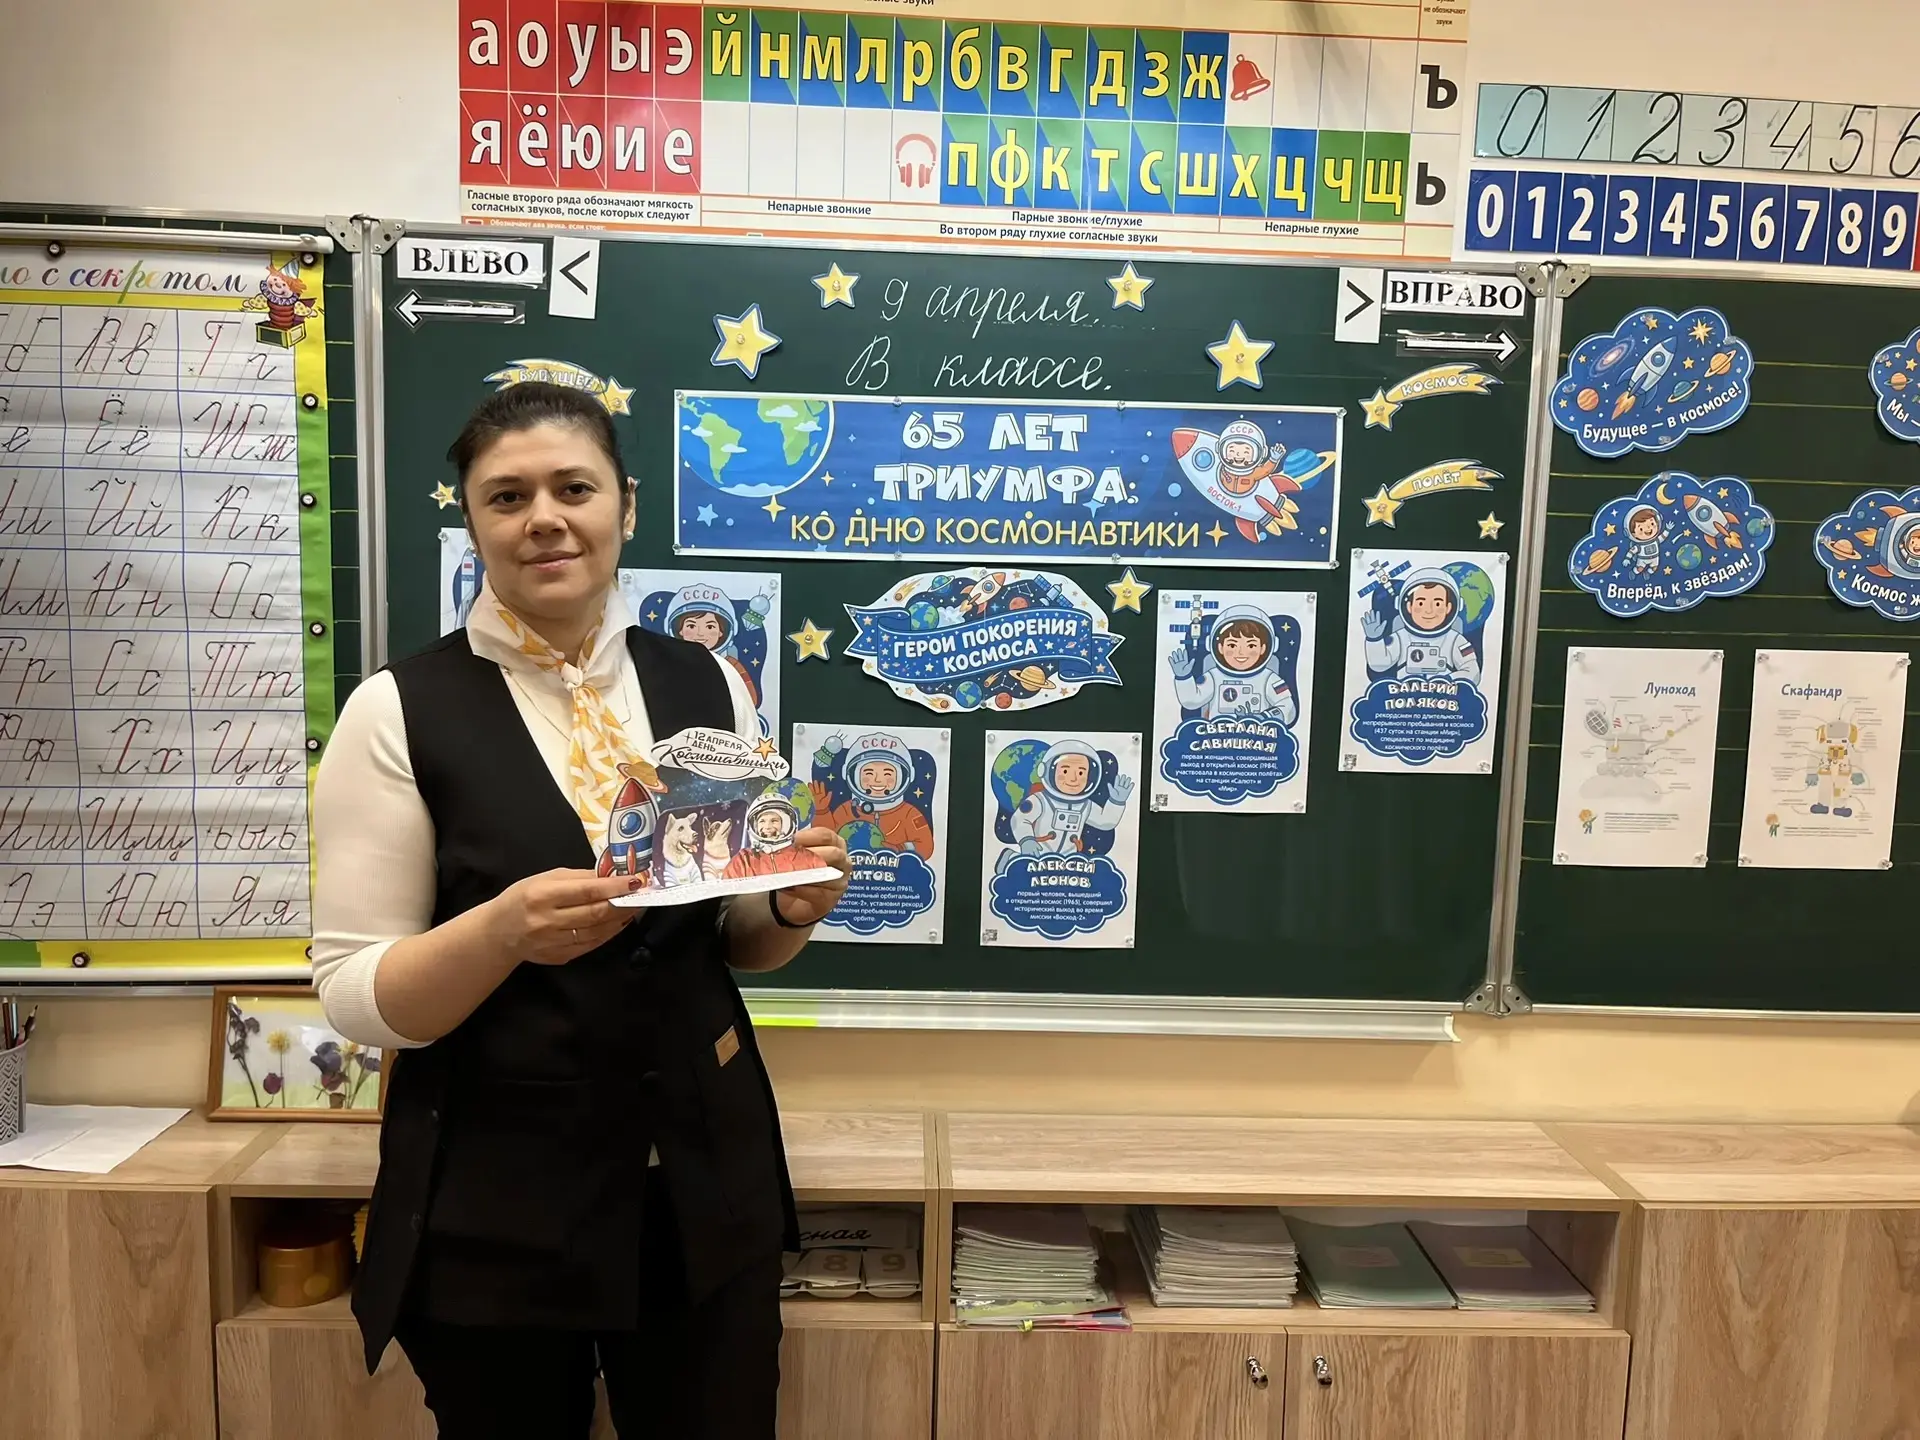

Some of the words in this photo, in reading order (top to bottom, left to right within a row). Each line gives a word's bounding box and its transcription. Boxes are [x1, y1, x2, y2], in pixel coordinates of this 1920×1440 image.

[467, 190, 509, 201] Гласные
[513, 194, 554, 204] второго
[557, 195, 582, 205] ряда
[584, 196, 645, 208] обозначают
[648, 200, 693, 210] мягкость
[768, 200, 823, 214] Непарные
[827, 205, 871, 215] звонкие
[472, 202, 524, 213] согласных
[527, 205, 565, 216] звуков,
[568, 207, 598, 217] после
[601, 209, 643, 219] которых
[647, 212, 690, 221] следуют
[1012, 211, 1054, 224] Парные
[1477, 185, 1503, 238] 0
[1527, 186, 1546, 239] 1
[1567, 188, 1594, 241] 2
[1614, 190, 1639, 243] 3
[1660, 192, 1686, 245] 4
[1704, 195, 1730, 247] 5
[1750, 198, 1775, 249] 6
[1795, 200, 1820, 251] 7
[1836, 202, 1863, 254] 8
[1882, 205, 1907, 257] 9
[940, 223, 954, 234] Во
[958, 227, 997, 238] втором
[1000, 229, 1025, 240] ряду
[1030, 230, 1065, 240] глухие
[1070, 232, 1124, 242] согласные
[1128, 234, 1157, 244] звуки
[1265, 222, 1319, 234] Непарные
[1323, 226, 1359, 236] глухие
[412, 247, 529, 276] ВЛЕВО
[69, 259, 248, 304] секретом
[881, 278, 908, 321] 9
[1390, 280, 1522, 309] ВПРАВО
[846, 335, 890, 391] В
[934, 354, 1111, 391] классе.
[1401, 375, 1468, 396] КОСМОС
[1583, 422, 1648, 444] Будущее
[1667, 416, 1677, 428] в
[1679, 381, 1742, 426] космосе!
[1886, 398, 1909, 423] Мы
[901, 411, 964, 449] 65
[989, 412, 1088, 452] ЛЕТ
[1230, 425, 1254, 435] СССР
[1411, 470, 1461, 491] ПОЛЁТ
[1207, 486, 1242, 512] ВОСТОК-1
[791, 514, 834, 542] КО
[844, 515, 925, 547] ДНЮ
[936, 517, 1199, 548] КОСМОНАВТИКИ
[1606, 581, 1668, 602] Вперёд,
[1672, 583, 1681, 595] к
[1683, 552, 1754, 592] звёздам!
[683, 591, 720, 602] СССР
[1851, 573, 1907, 604] Космос
[893, 636, 956, 659] ГЕРОИ
[961, 618, 1078, 650] ПОКОРЕНИЯ
[943, 638, 1038, 675] КОСМОСА
[1388, 682, 1458, 695] ВАЛЕРИЙ
[1643, 681, 1697, 698] Луноход
[1780, 683, 1843, 701] Скафандр
[1385, 698, 1459, 711] ПОЛЯКОВ
[1195, 723, 1278, 738] СВЕТЛАНА
[691, 740, 716, 752] ДЕНЬ
[694, 731, 706, 741] 12
[704, 736, 742, 750] АПРЕЛЯ
[861, 738, 898, 750] СССР
[1189, 739, 1277, 753] САВИЦКАЯ
[851, 855, 899, 868] ЕРМАН
[1027, 860, 1096, 874] АЛЕКСЕЙ
[850, 870, 896, 882] ИТОВ
[1031, 876, 1091, 888] ЛЕОНОВ
[800, 1229, 871, 1242] сная
[823, 1254, 848, 1272] 8
[881, 1253, 906, 1272] 9
